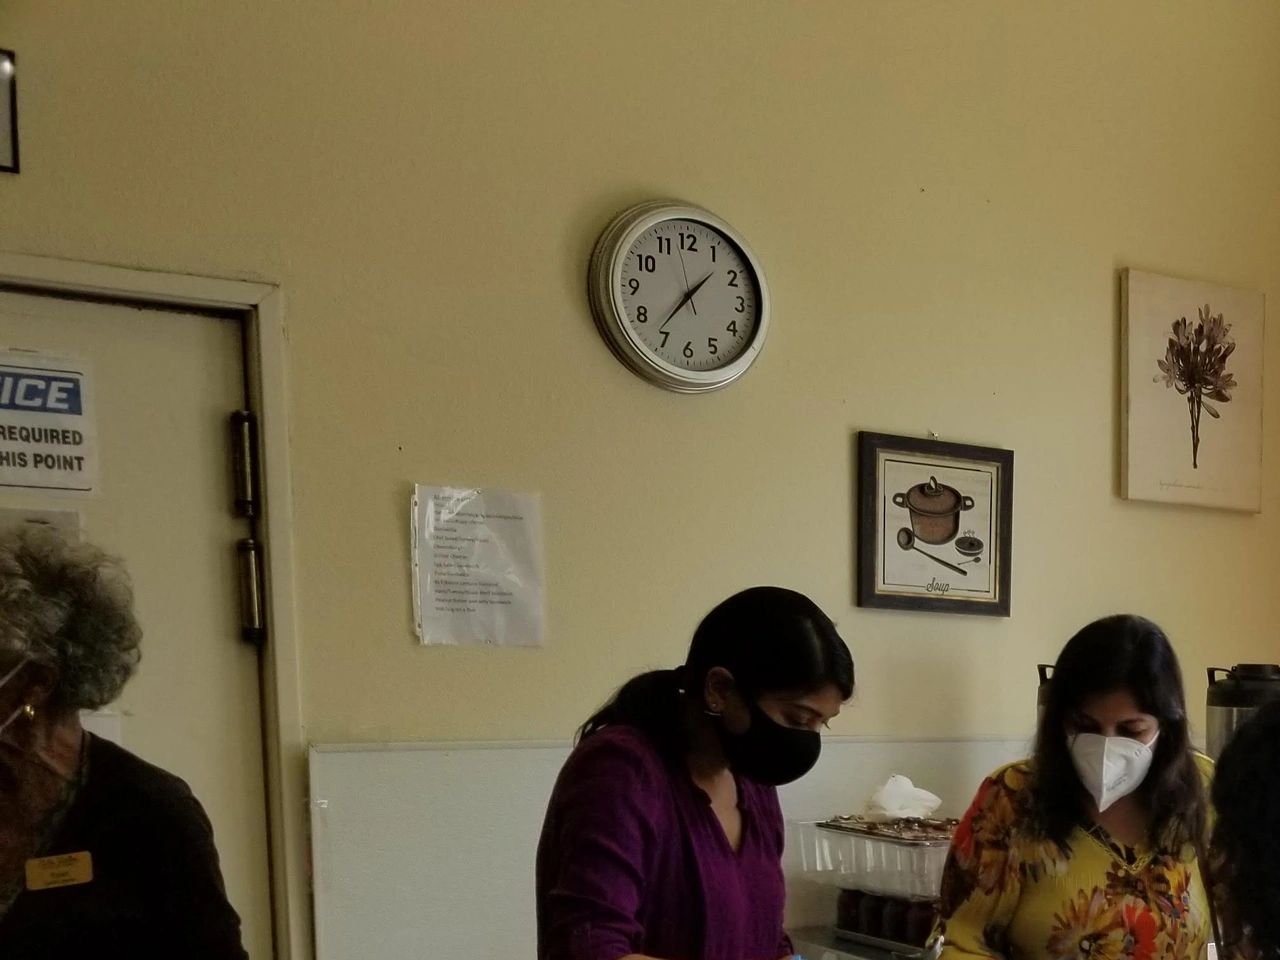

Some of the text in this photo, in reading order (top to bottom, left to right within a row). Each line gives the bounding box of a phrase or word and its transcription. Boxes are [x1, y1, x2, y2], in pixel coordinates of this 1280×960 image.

[657, 236, 671, 255] 11
[678, 233, 698, 252] 12
[710, 245, 716, 262] 1
[637, 254, 656, 272] 10
[629, 278, 639, 295] 9
[727, 270, 738, 288] 2
[735, 296, 745, 313] 3
[636, 306, 648, 323] 8
[726, 320, 738, 336] 4
[659, 331, 670, 347] 7
[708, 338, 718, 354] 5
[683, 341, 694, 358] 6
[0, 376, 74, 410] ICE
[0, 425, 83, 446] REQUIRED
[33, 453, 84, 471] POINT
[926, 577, 950, 595] Soup
